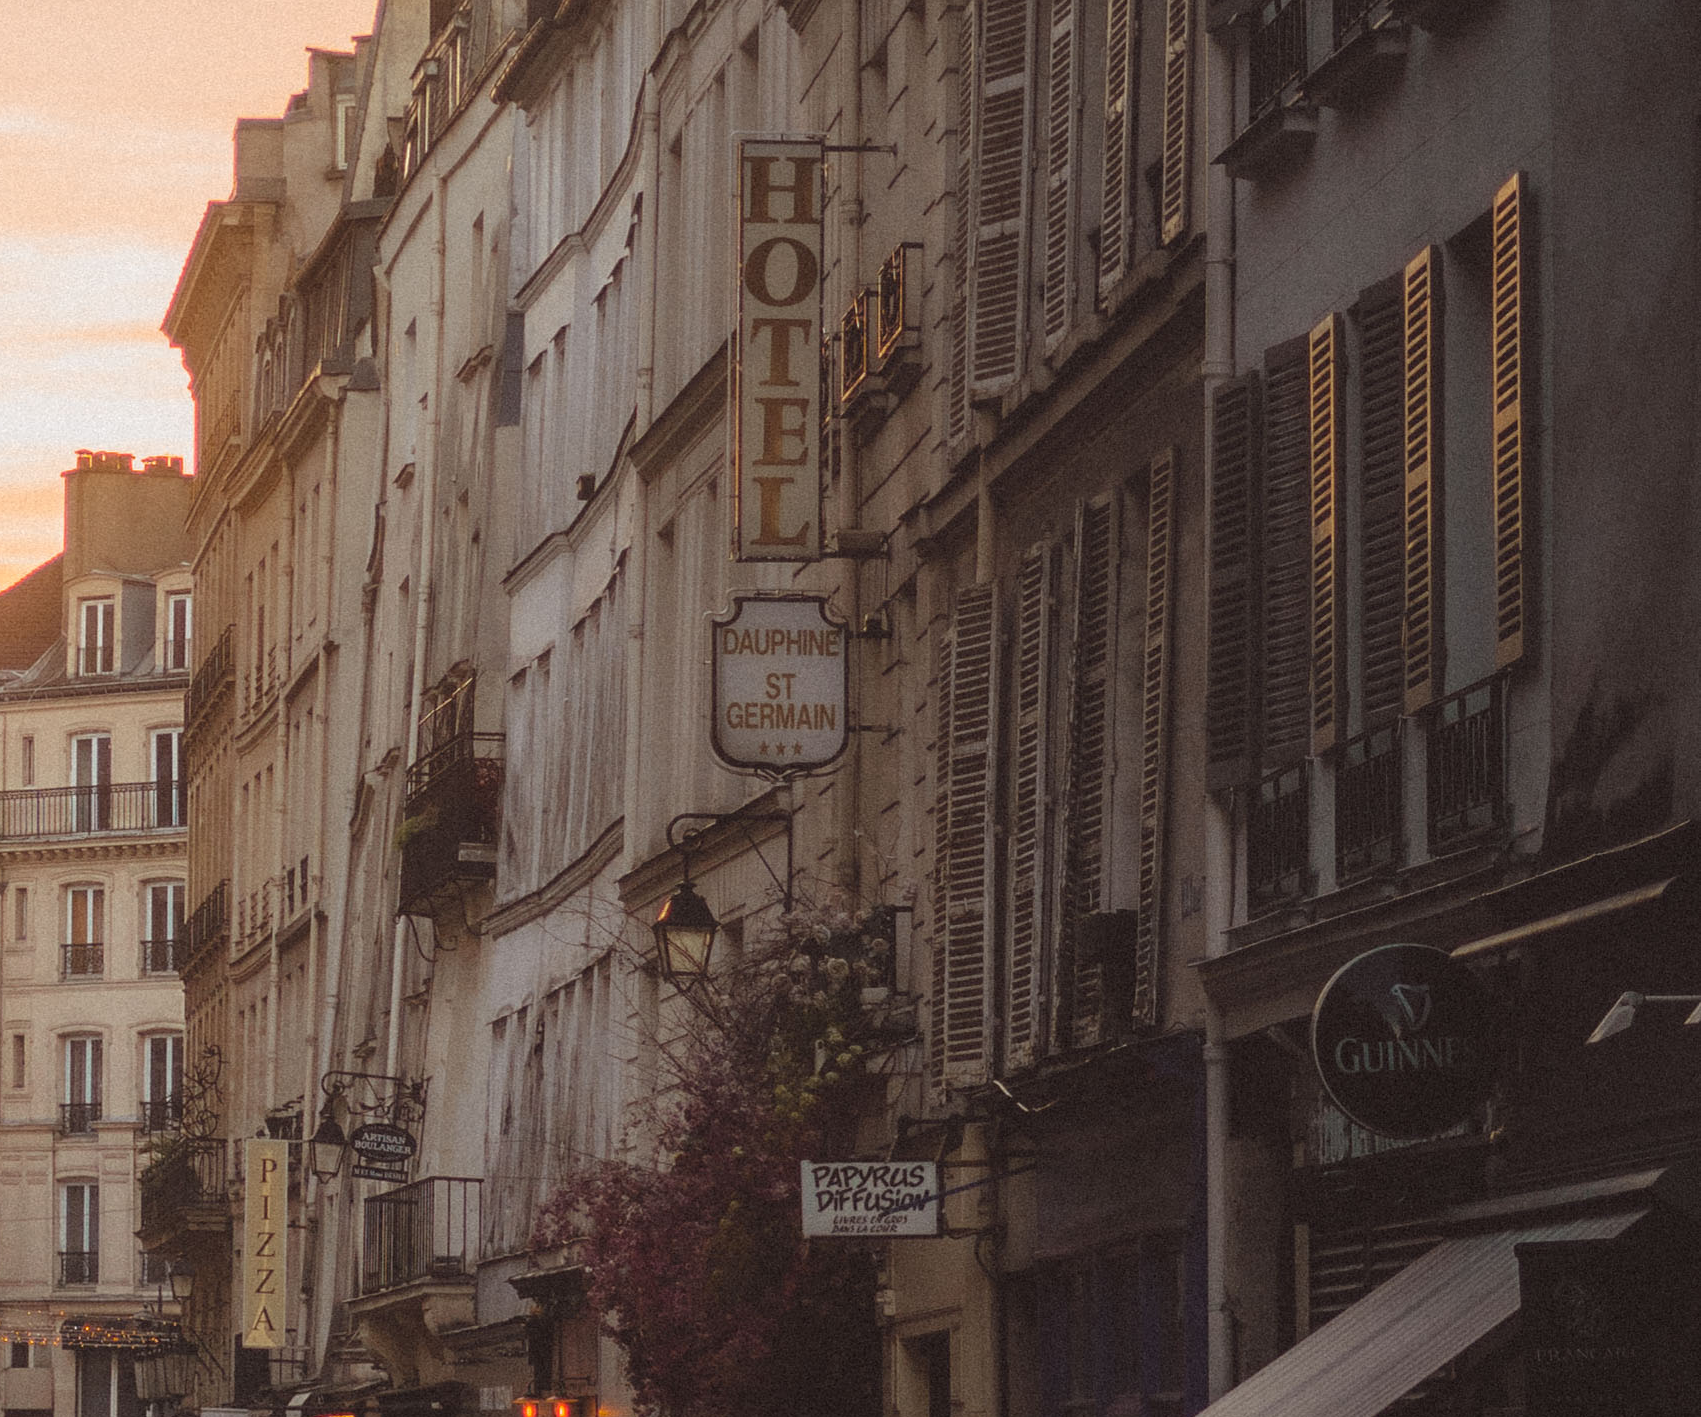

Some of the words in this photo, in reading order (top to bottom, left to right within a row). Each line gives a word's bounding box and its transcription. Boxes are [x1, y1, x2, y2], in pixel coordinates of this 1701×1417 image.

[743, 156, 821, 545] HOTEL
[722, 628, 839, 657] DAUPHINE
[765, 672, 796, 700] ST
[726, 702, 836, 731] GERMAIN
[355, 1140, 411, 1155] BOULANGER
[362, 1132, 406, 1144] ARTISAN
[811, 1165, 925, 1188] PAPYRUS
[252, 1158, 278, 1332] PIZZA
